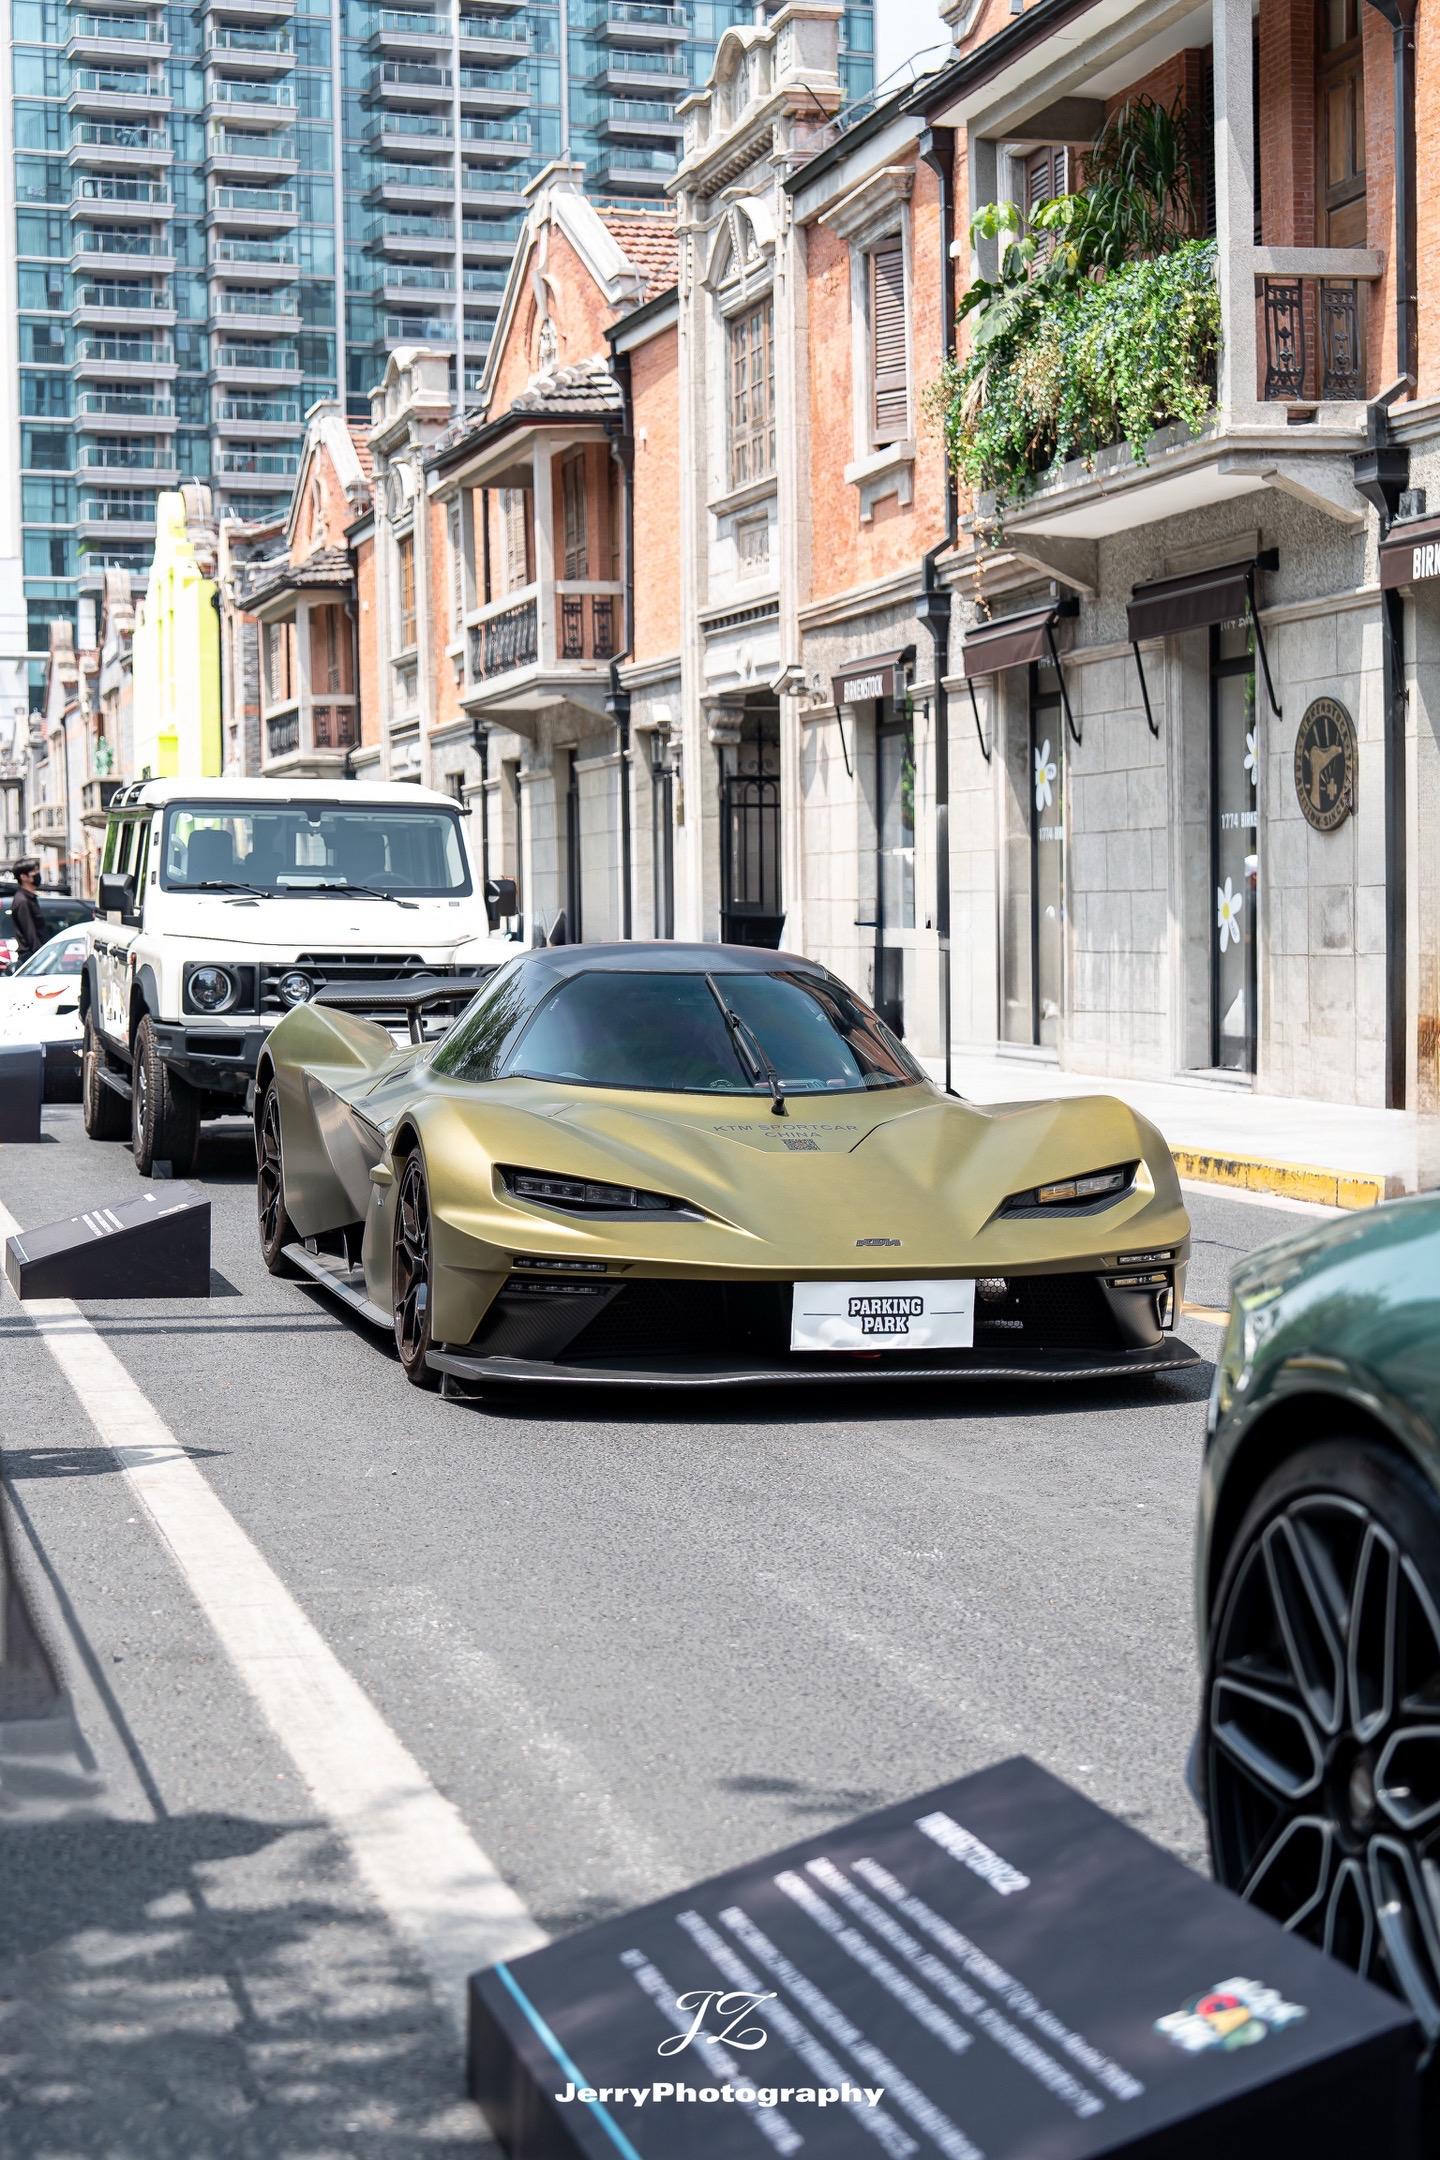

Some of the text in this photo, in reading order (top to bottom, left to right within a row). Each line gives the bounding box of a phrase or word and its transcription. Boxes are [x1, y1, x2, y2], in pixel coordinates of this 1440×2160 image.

[1221, 813, 1239, 829] 1774
[849, 1297, 922, 1316] PARKING
[863, 1316, 908, 1333] PARK
